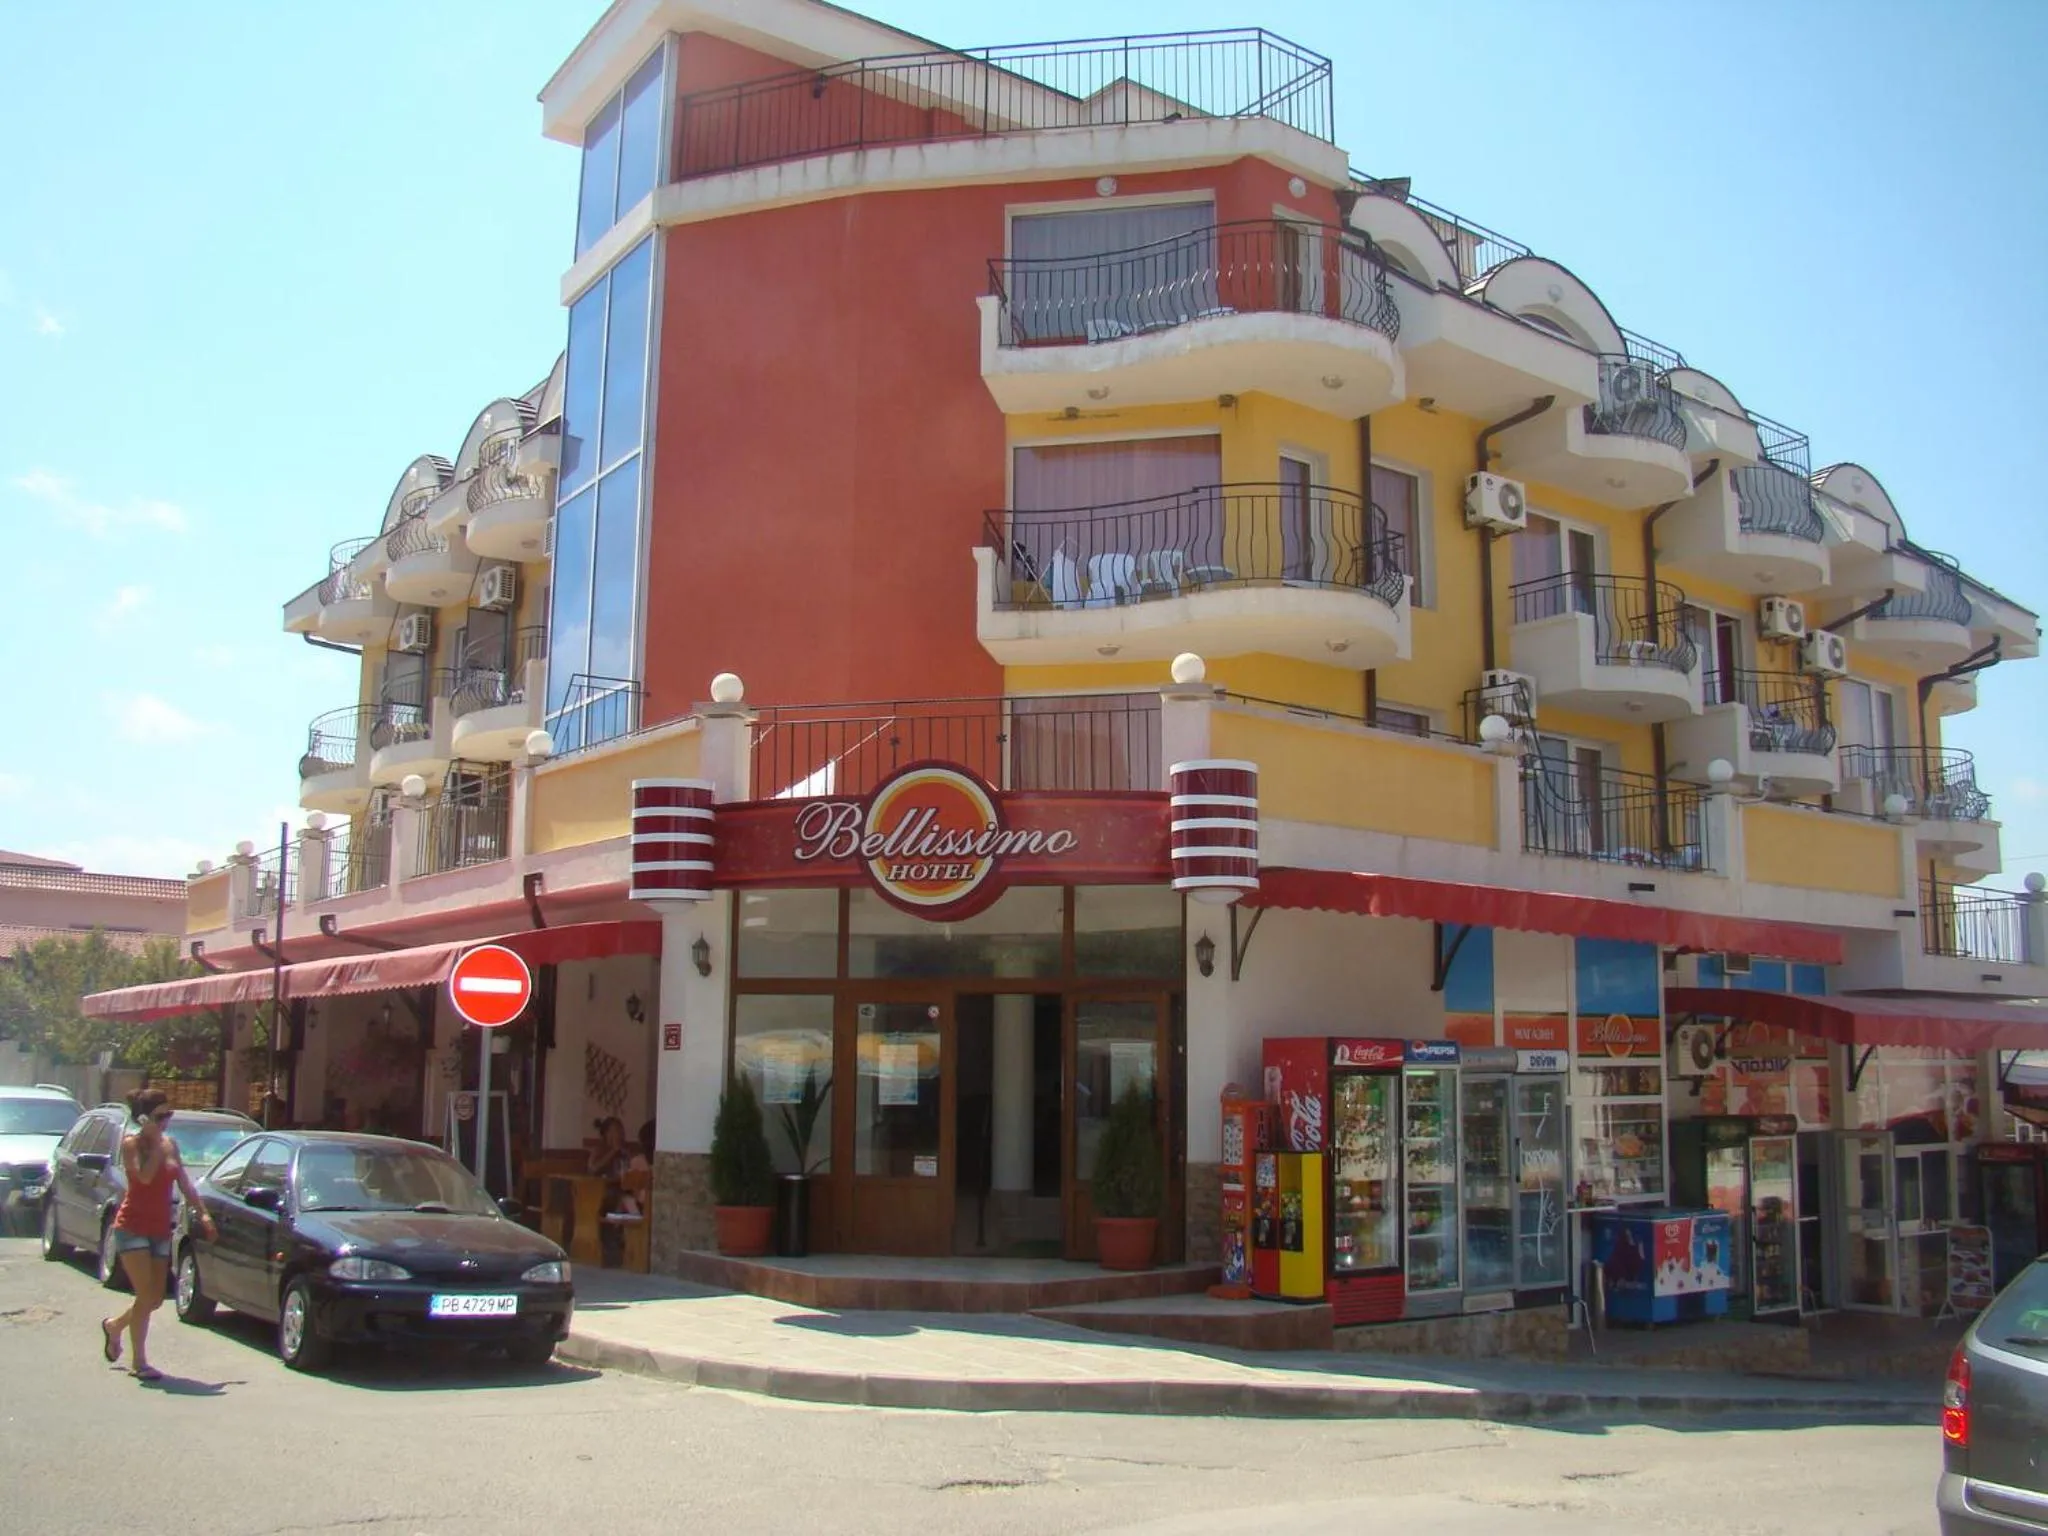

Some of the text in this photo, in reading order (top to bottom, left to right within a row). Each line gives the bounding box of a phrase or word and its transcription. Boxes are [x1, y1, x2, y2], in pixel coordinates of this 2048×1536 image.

[794, 801, 1079, 860] Bellissimo
[886, 863, 975, 881] HOTEL
[1427, 1046, 1456, 1055] PEPSI
[1529, 1054, 1557, 1067] DEVIN
[442, 1298, 460, 1313] PB
[463, 1298, 495, 1312] 4729
